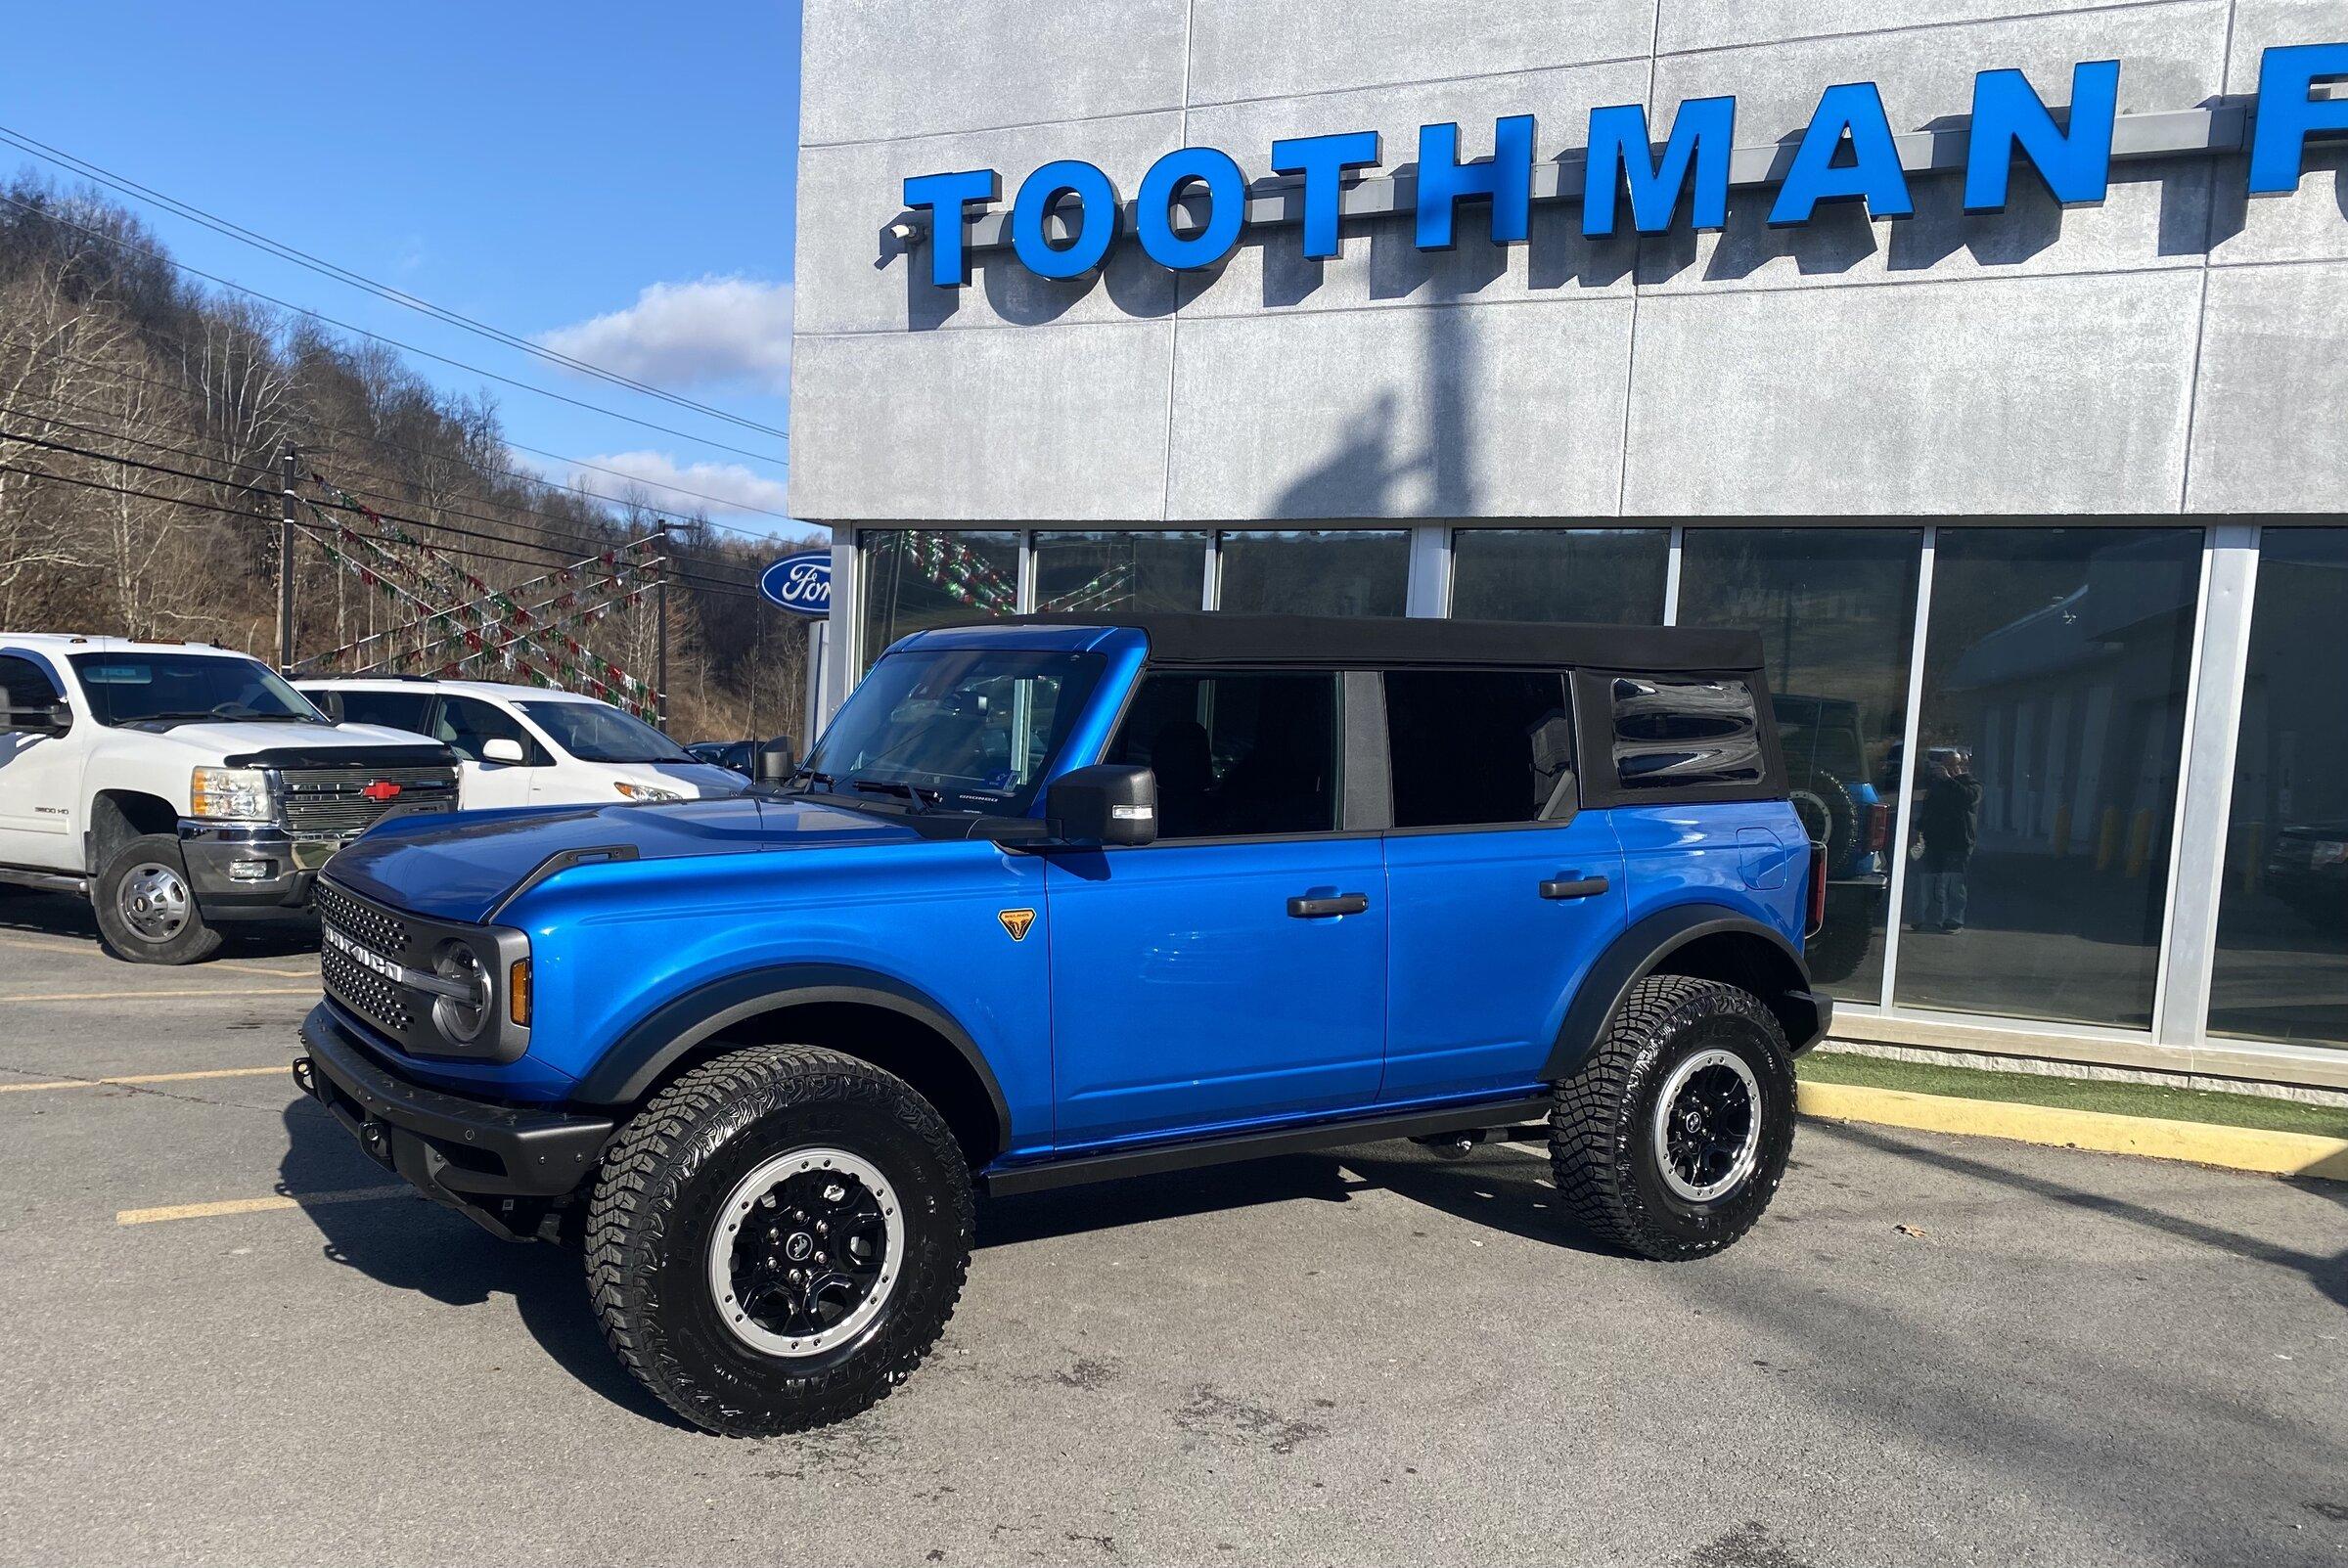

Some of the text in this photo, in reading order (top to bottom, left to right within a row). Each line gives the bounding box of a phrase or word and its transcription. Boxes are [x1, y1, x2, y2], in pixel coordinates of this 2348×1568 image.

[902, 42, 2348, 288] TOOTHMAN F
[325, 925, 402, 982] BRONCO
